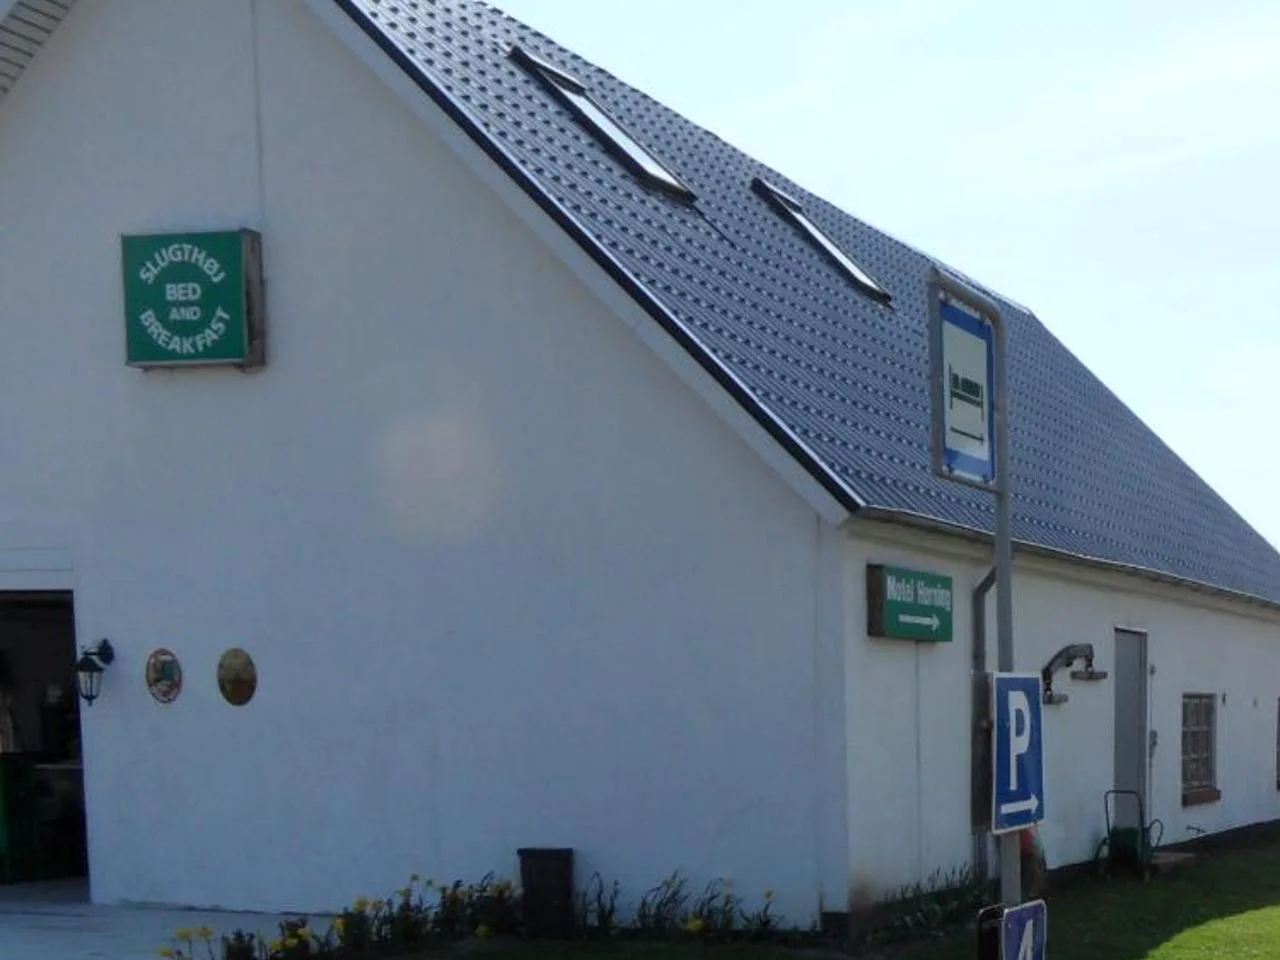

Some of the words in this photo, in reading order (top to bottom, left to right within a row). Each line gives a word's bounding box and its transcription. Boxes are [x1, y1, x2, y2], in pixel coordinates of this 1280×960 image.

[165, 283, 201, 301] BED
[169, 306, 201, 321] AND
[139, 304, 231, 354] BREAKFAST
[887, 575, 914, 602] Motel
[1008, 690, 1031, 791] P
